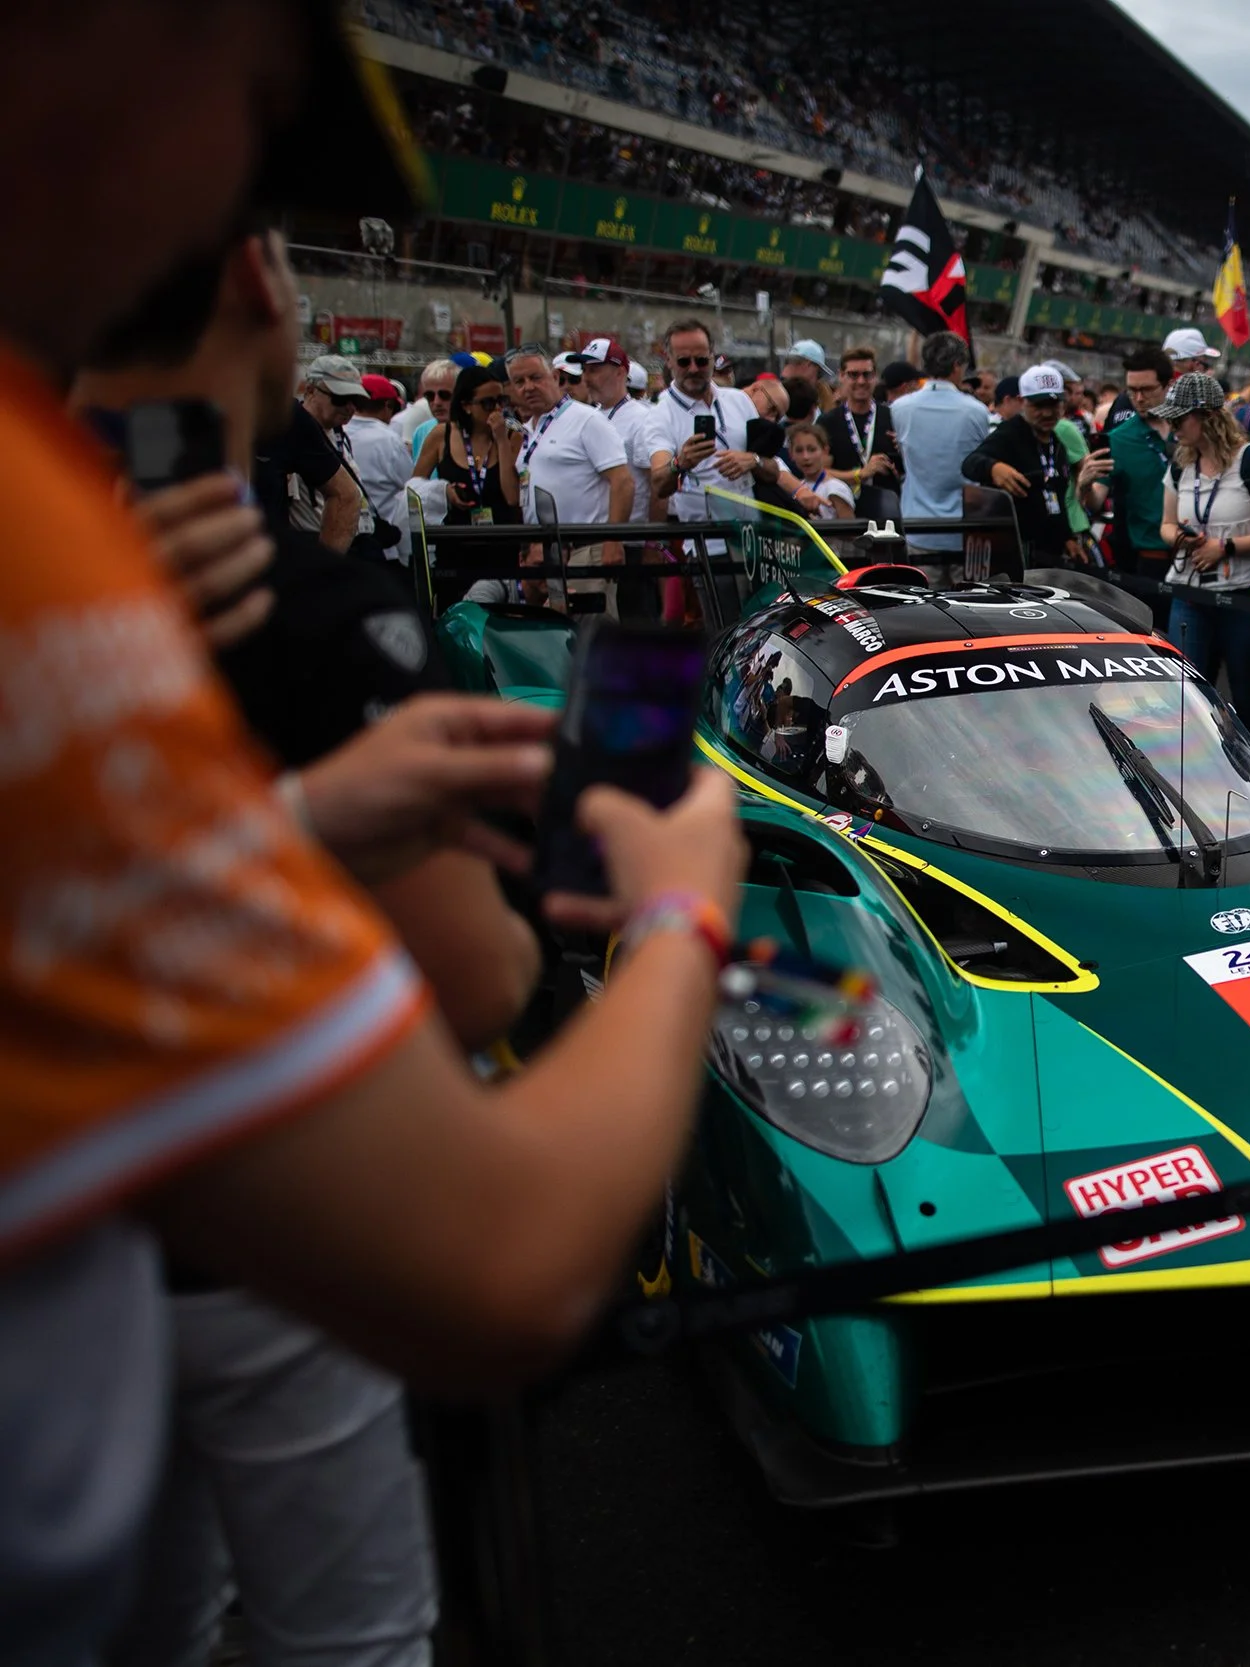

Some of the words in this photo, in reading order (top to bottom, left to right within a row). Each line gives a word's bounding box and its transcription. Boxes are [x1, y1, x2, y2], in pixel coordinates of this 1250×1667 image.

[490, 202, 538, 226] ROLEX
[595, 219, 636, 243] ROLEX
[758, 536, 774, 560] THE
[774, 541, 801, 568] HEART
[965, 535, 992, 582] 009
[760, 562, 770, 583] OF
[843, 620, 883, 653] MARCO
[872, 660, 1046, 702] ASTON
[1056, 657, 1207, 682] MARTIN
[1079, 1157, 1203, 1211] HYPER
